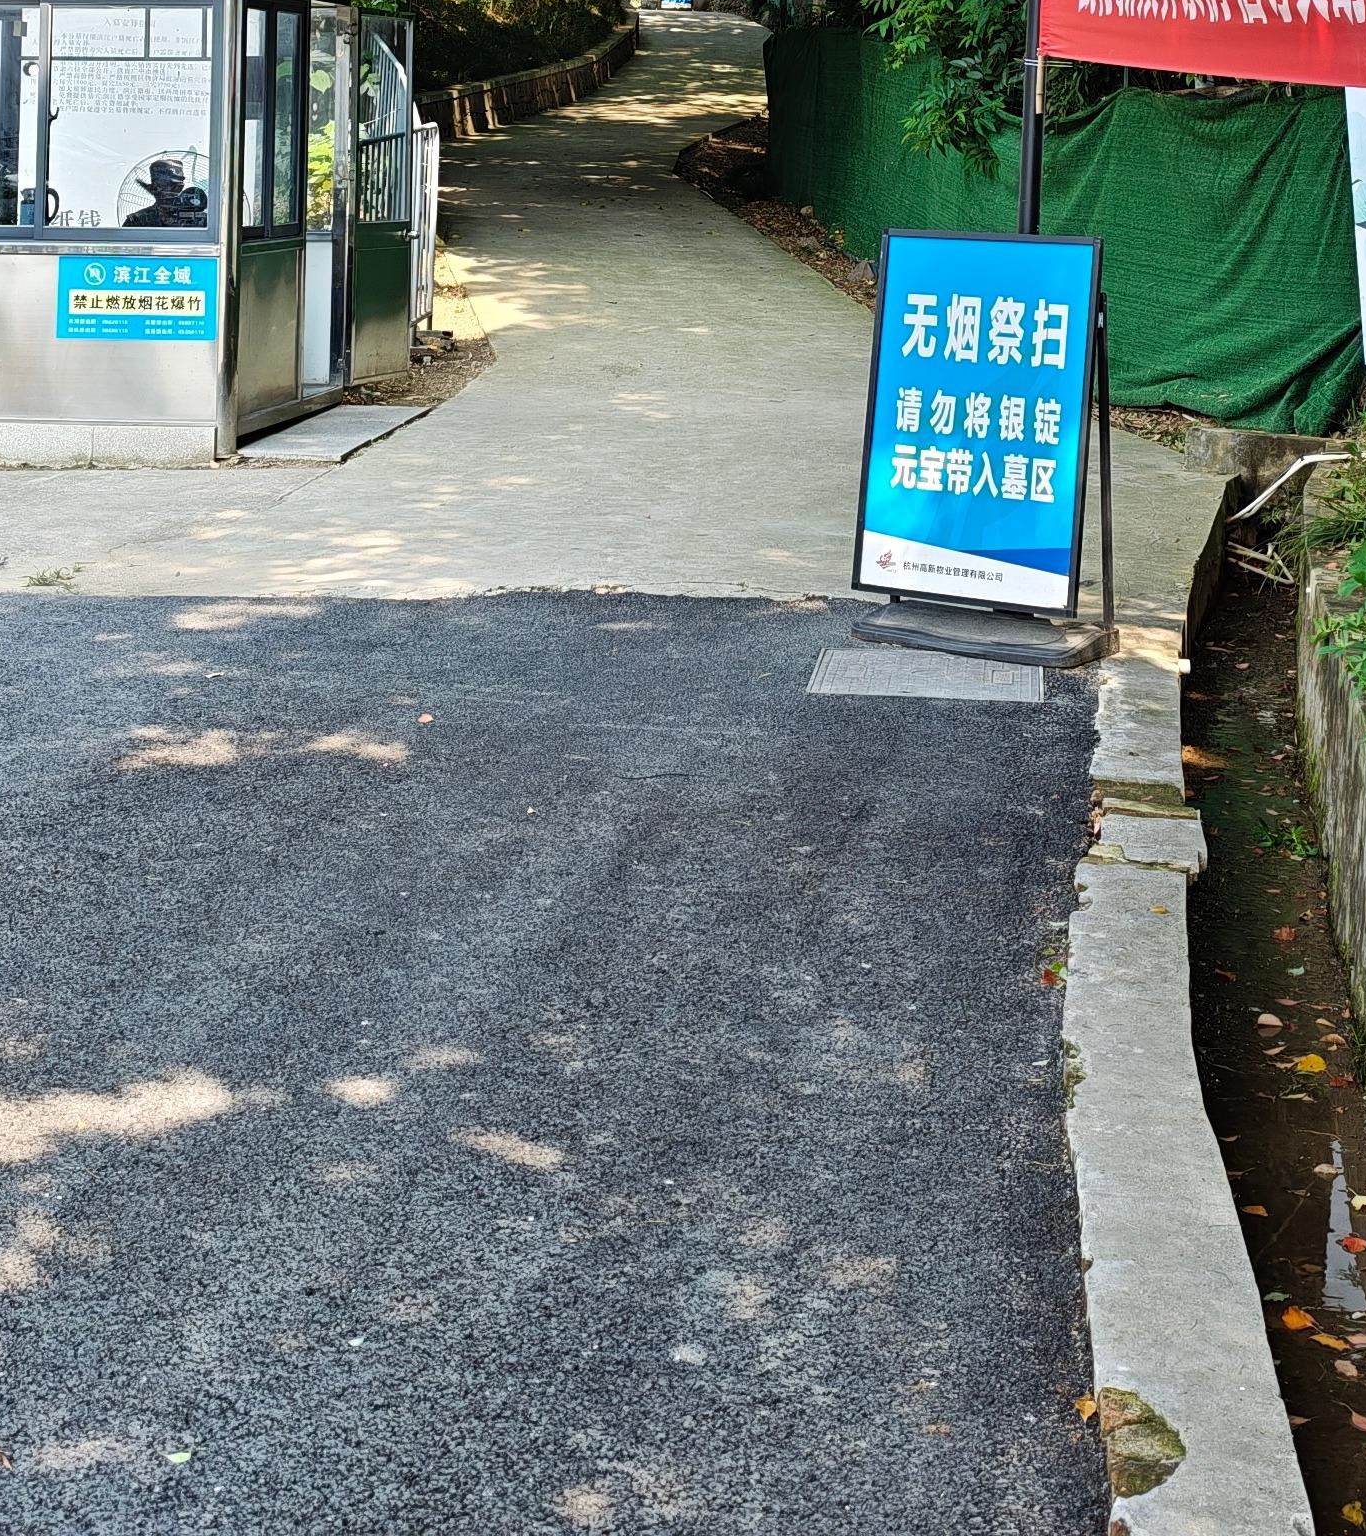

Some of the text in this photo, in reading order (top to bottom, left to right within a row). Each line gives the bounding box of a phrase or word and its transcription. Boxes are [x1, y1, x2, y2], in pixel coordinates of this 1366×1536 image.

[73, 294, 202, 312] 禁止燃放烟花爆竹
[113, 266, 193, 285] 滨江全域
[901, 294, 1070, 369] 无烟祭扫
[895, 387, 1062, 445] 请勿将银锭
[890, 445, 1057, 503] 元宝带入墓区
